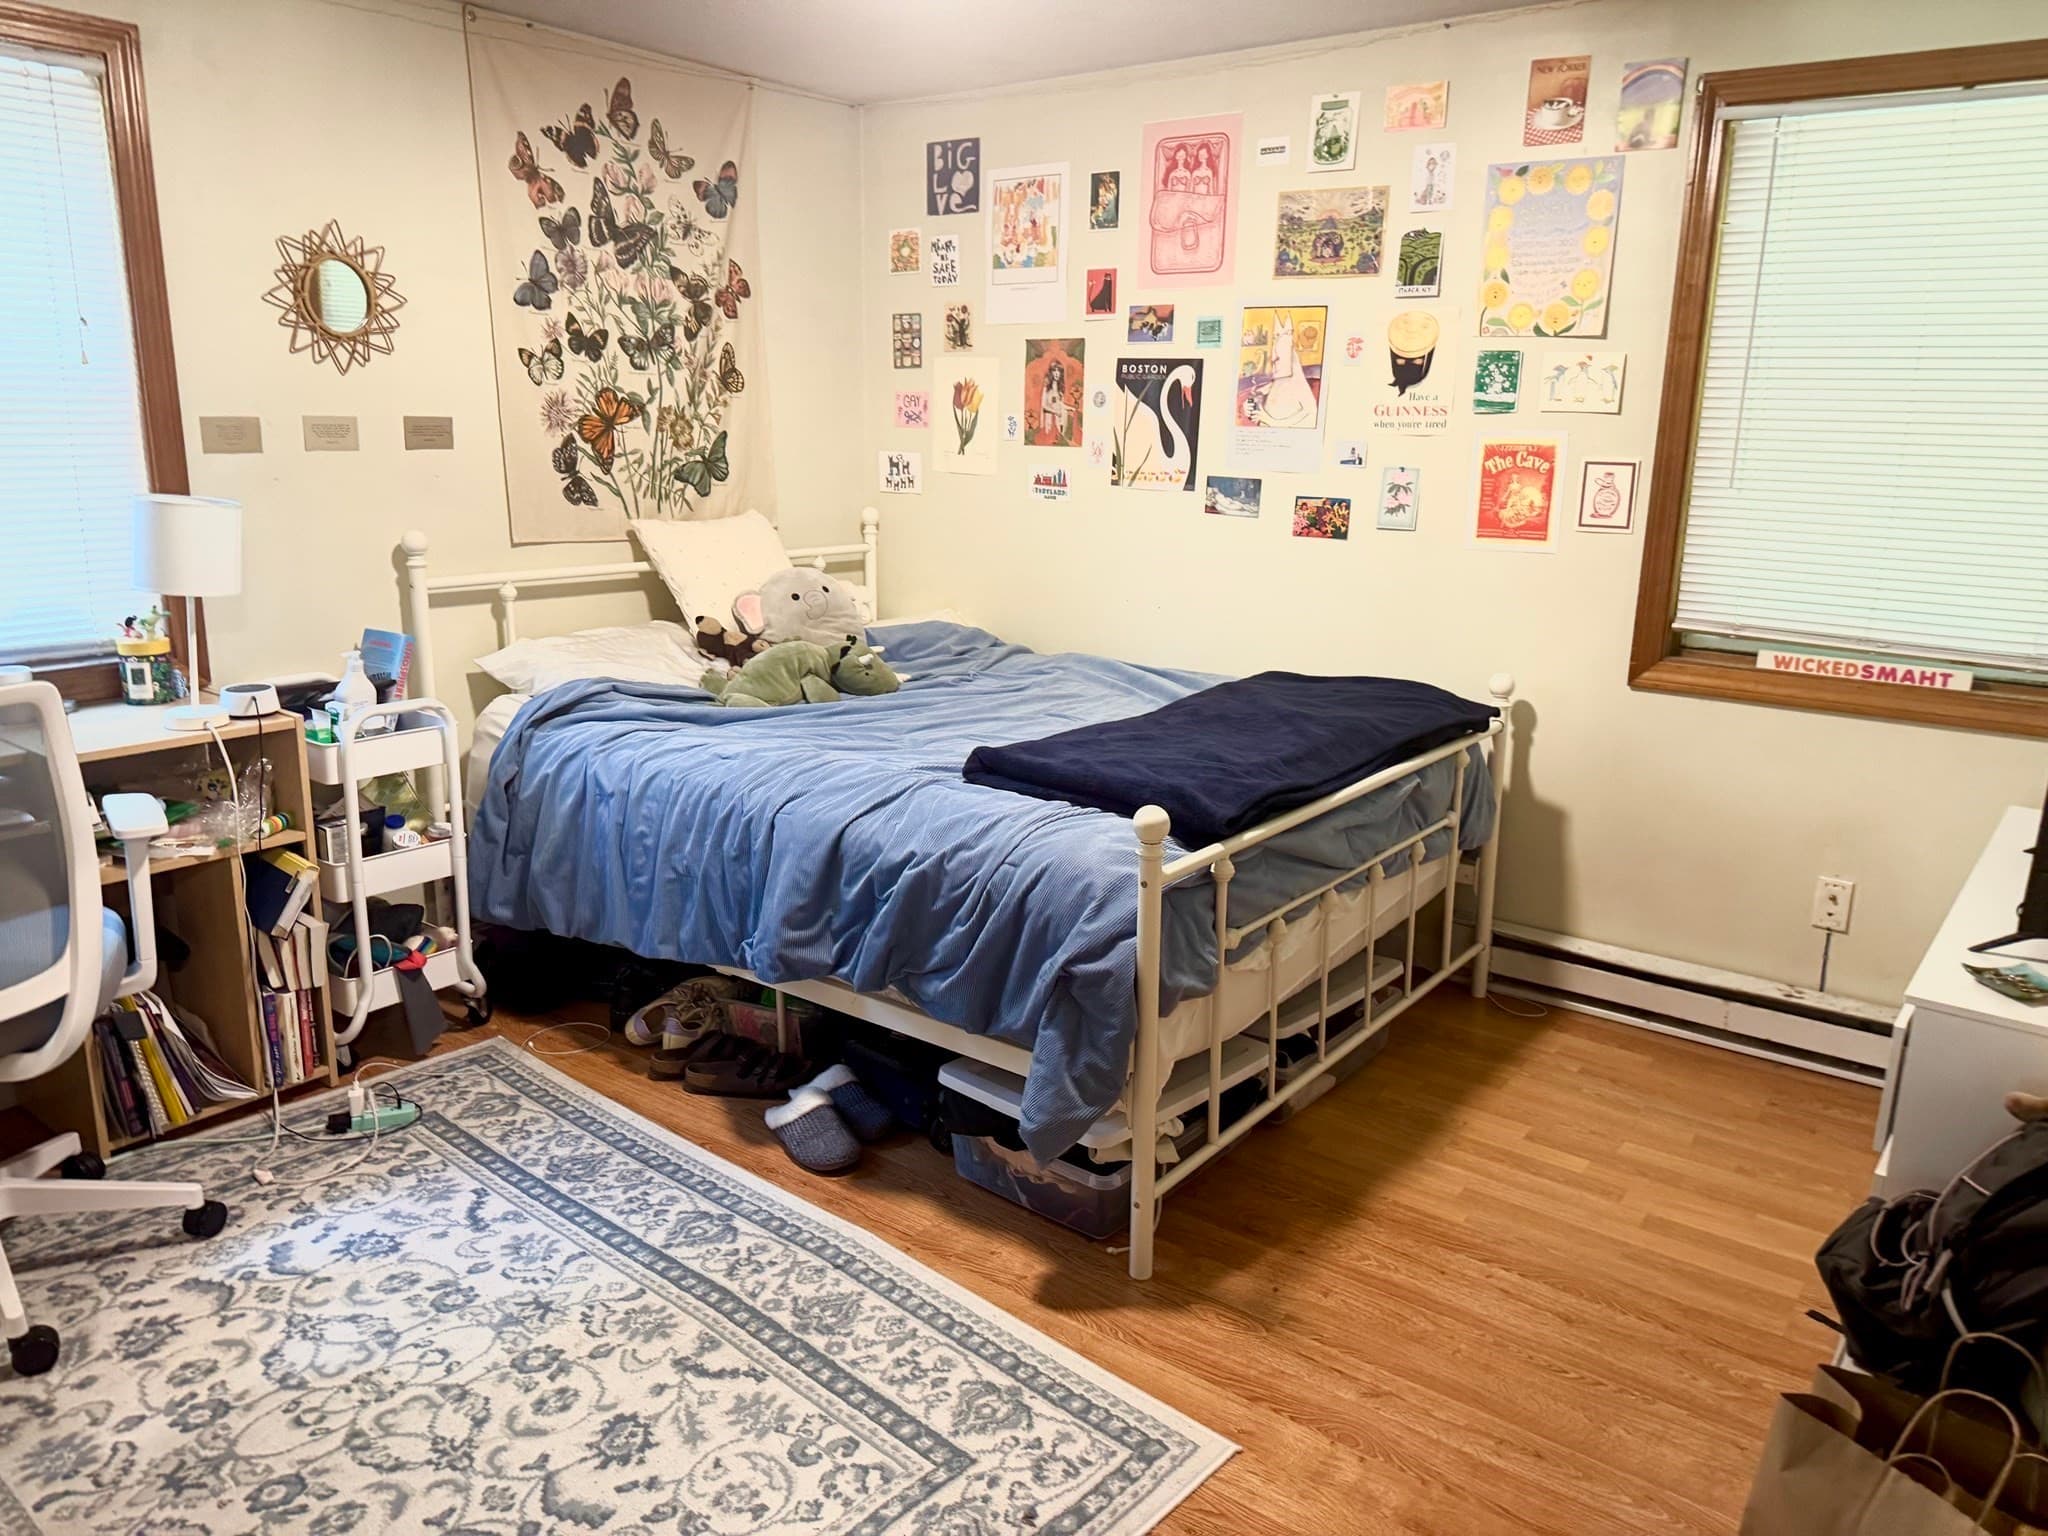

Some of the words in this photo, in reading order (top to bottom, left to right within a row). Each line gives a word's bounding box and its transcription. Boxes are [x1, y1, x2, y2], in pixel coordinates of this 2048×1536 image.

[932, 259, 956, 273] SAFE
[1122, 364, 1167, 374] BOSTON
[1409, 392, 1430, 401] Have
[1374, 404, 1448, 417] GUINNESS
[1374, 420, 1395, 429] when
[1425, 419, 1447, 429] tired
[1484, 456, 1513, 474] The
[1515, 451, 1551, 474] Cave
